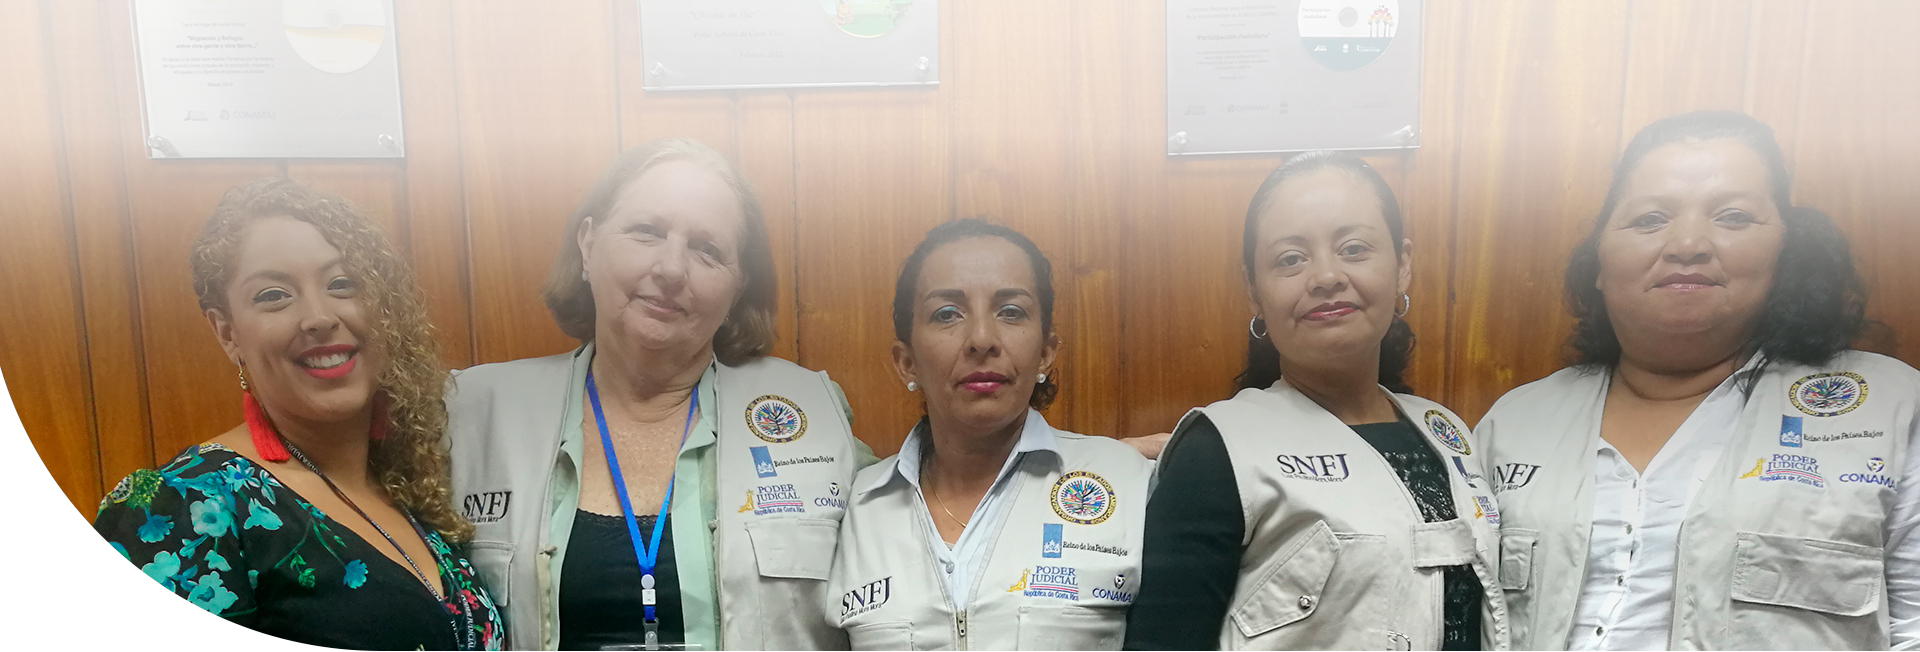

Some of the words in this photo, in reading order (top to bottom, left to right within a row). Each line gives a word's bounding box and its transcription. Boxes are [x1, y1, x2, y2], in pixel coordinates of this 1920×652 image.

[233, 111, 276, 119] CONAMAJ
[1773, 453, 1817, 465] PODER
[1277, 453, 1349, 481] SNFJ
[1766, 461, 1819, 474] JUDICIAL
[757, 484, 795, 493] PODER
[757, 492, 800, 505] JUDICIAL
[462, 491, 512, 520] SNFJ
[1080, 542, 1086, 550] de
[1112, 546, 1128, 557] Bajos
[1036, 565, 1076, 576] PODER
[1030, 573, 1079, 586] JUDICIAL
[841, 575, 892, 617] SNFJ
